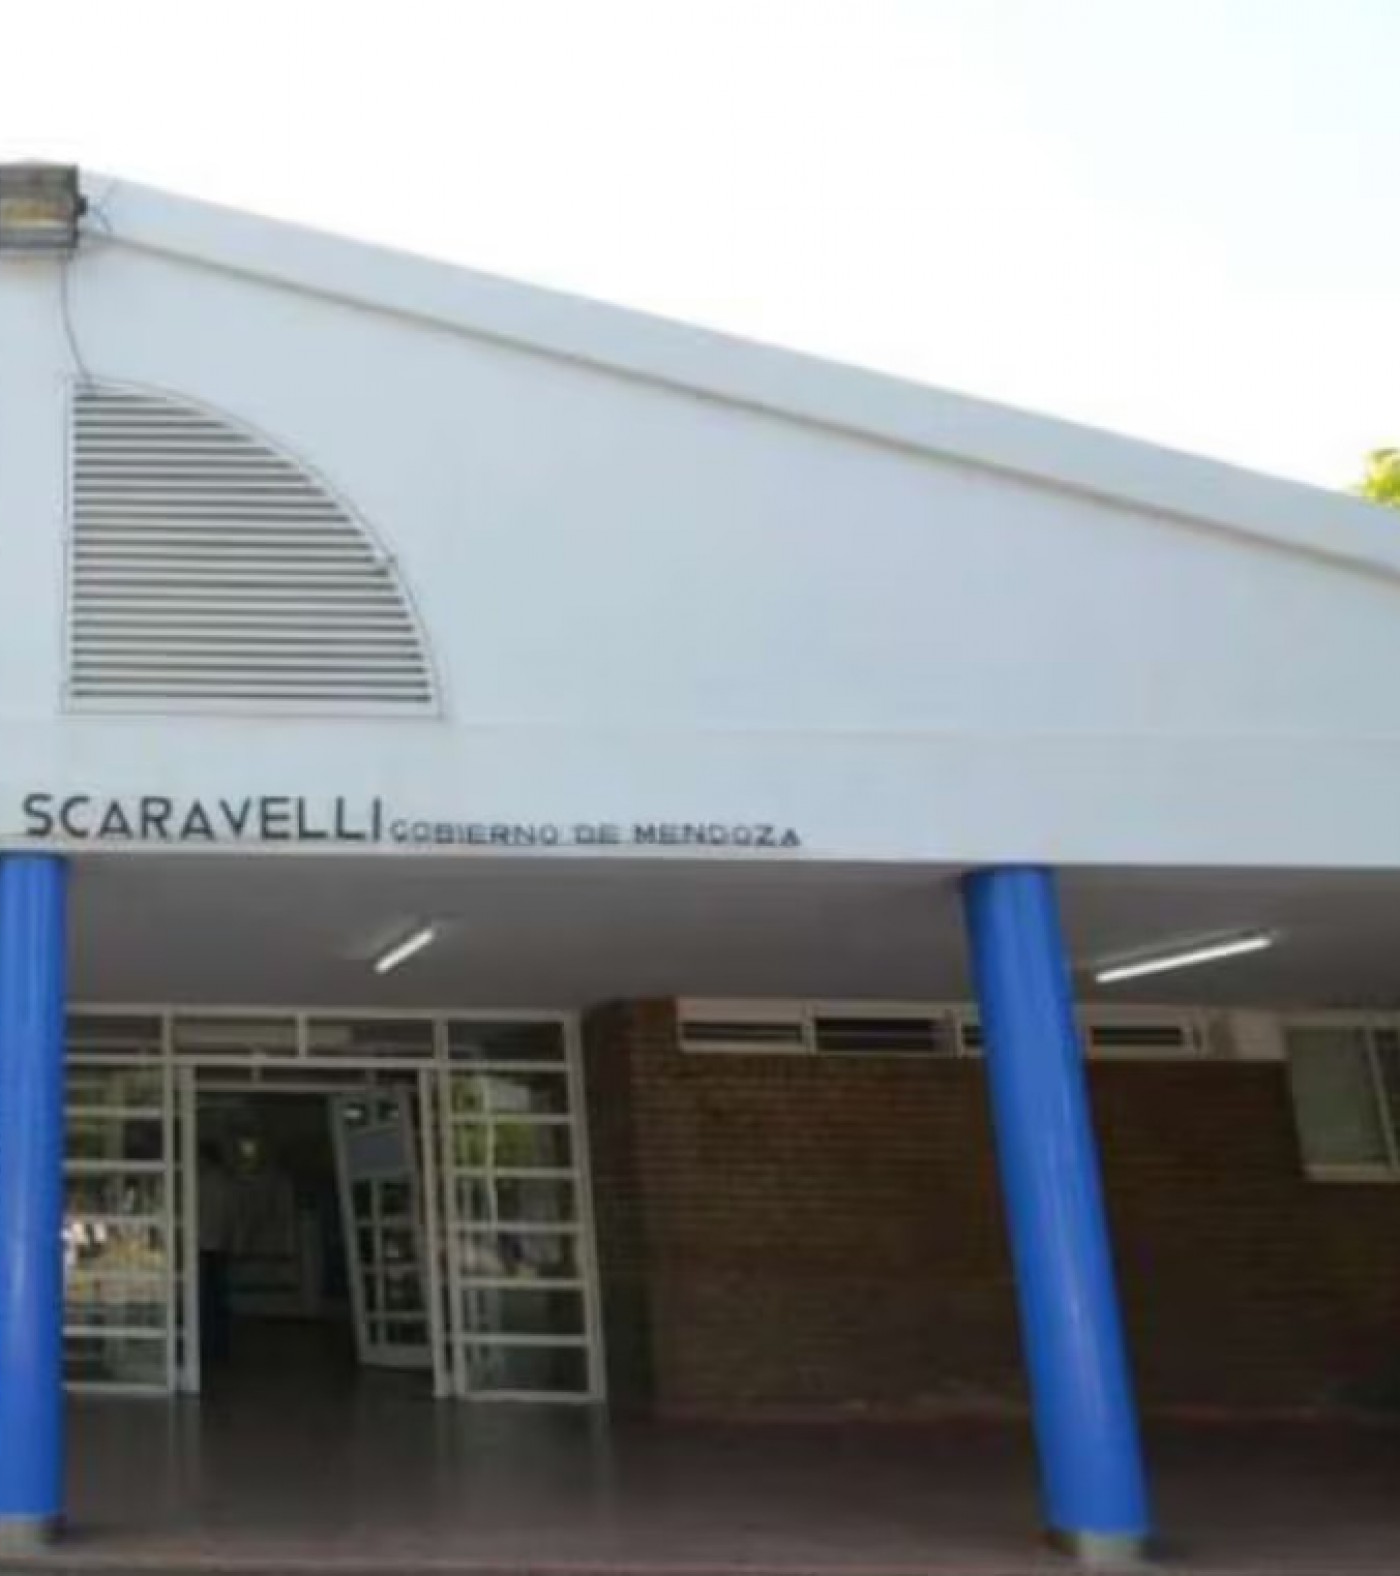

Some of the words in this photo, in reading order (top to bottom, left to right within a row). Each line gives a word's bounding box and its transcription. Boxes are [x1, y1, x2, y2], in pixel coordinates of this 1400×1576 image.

[22, 793, 382, 842] SCARAVELLI
[390, 818, 559, 846] GOBIERNO
[575, 822, 620, 846] DE
[634, 822, 802, 848] MENDOZA
